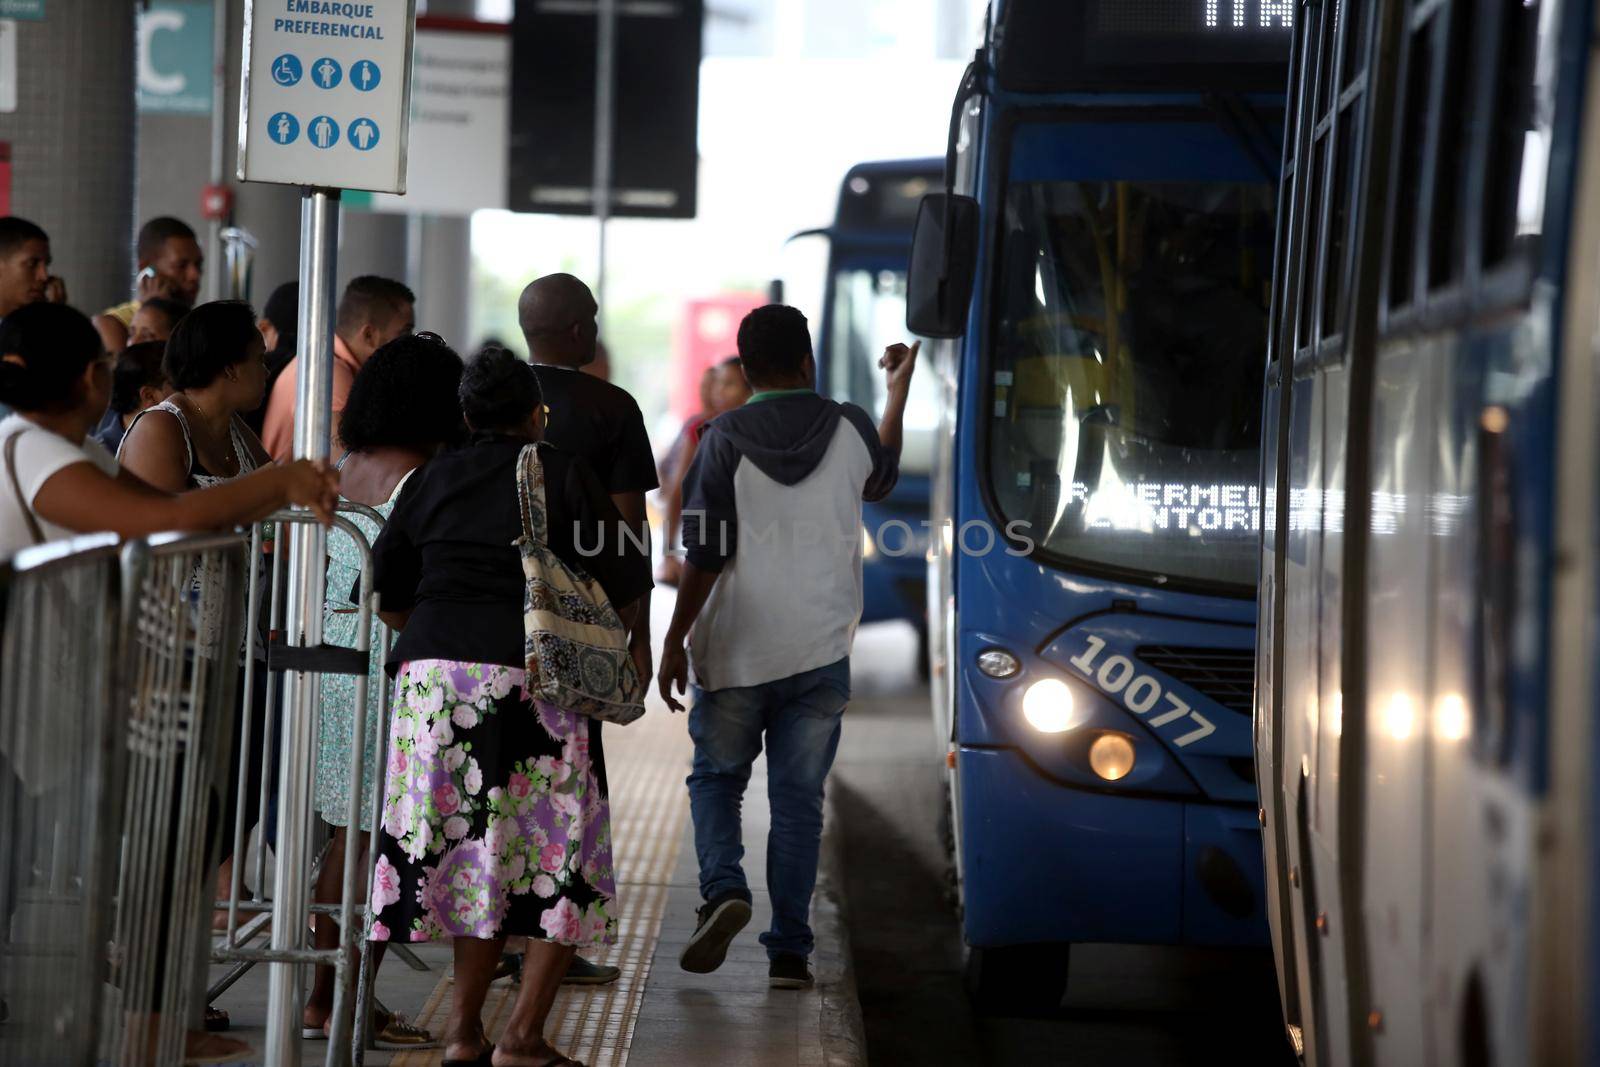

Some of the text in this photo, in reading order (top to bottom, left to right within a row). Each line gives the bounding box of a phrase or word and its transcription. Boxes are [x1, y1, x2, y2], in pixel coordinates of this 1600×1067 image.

[274, 18, 385, 40] PREFERENCIAL
[286, 0, 373, 19] EMBARQUE
[136, 8, 186, 95] C
[1070, 636, 1216, 749] 10077
